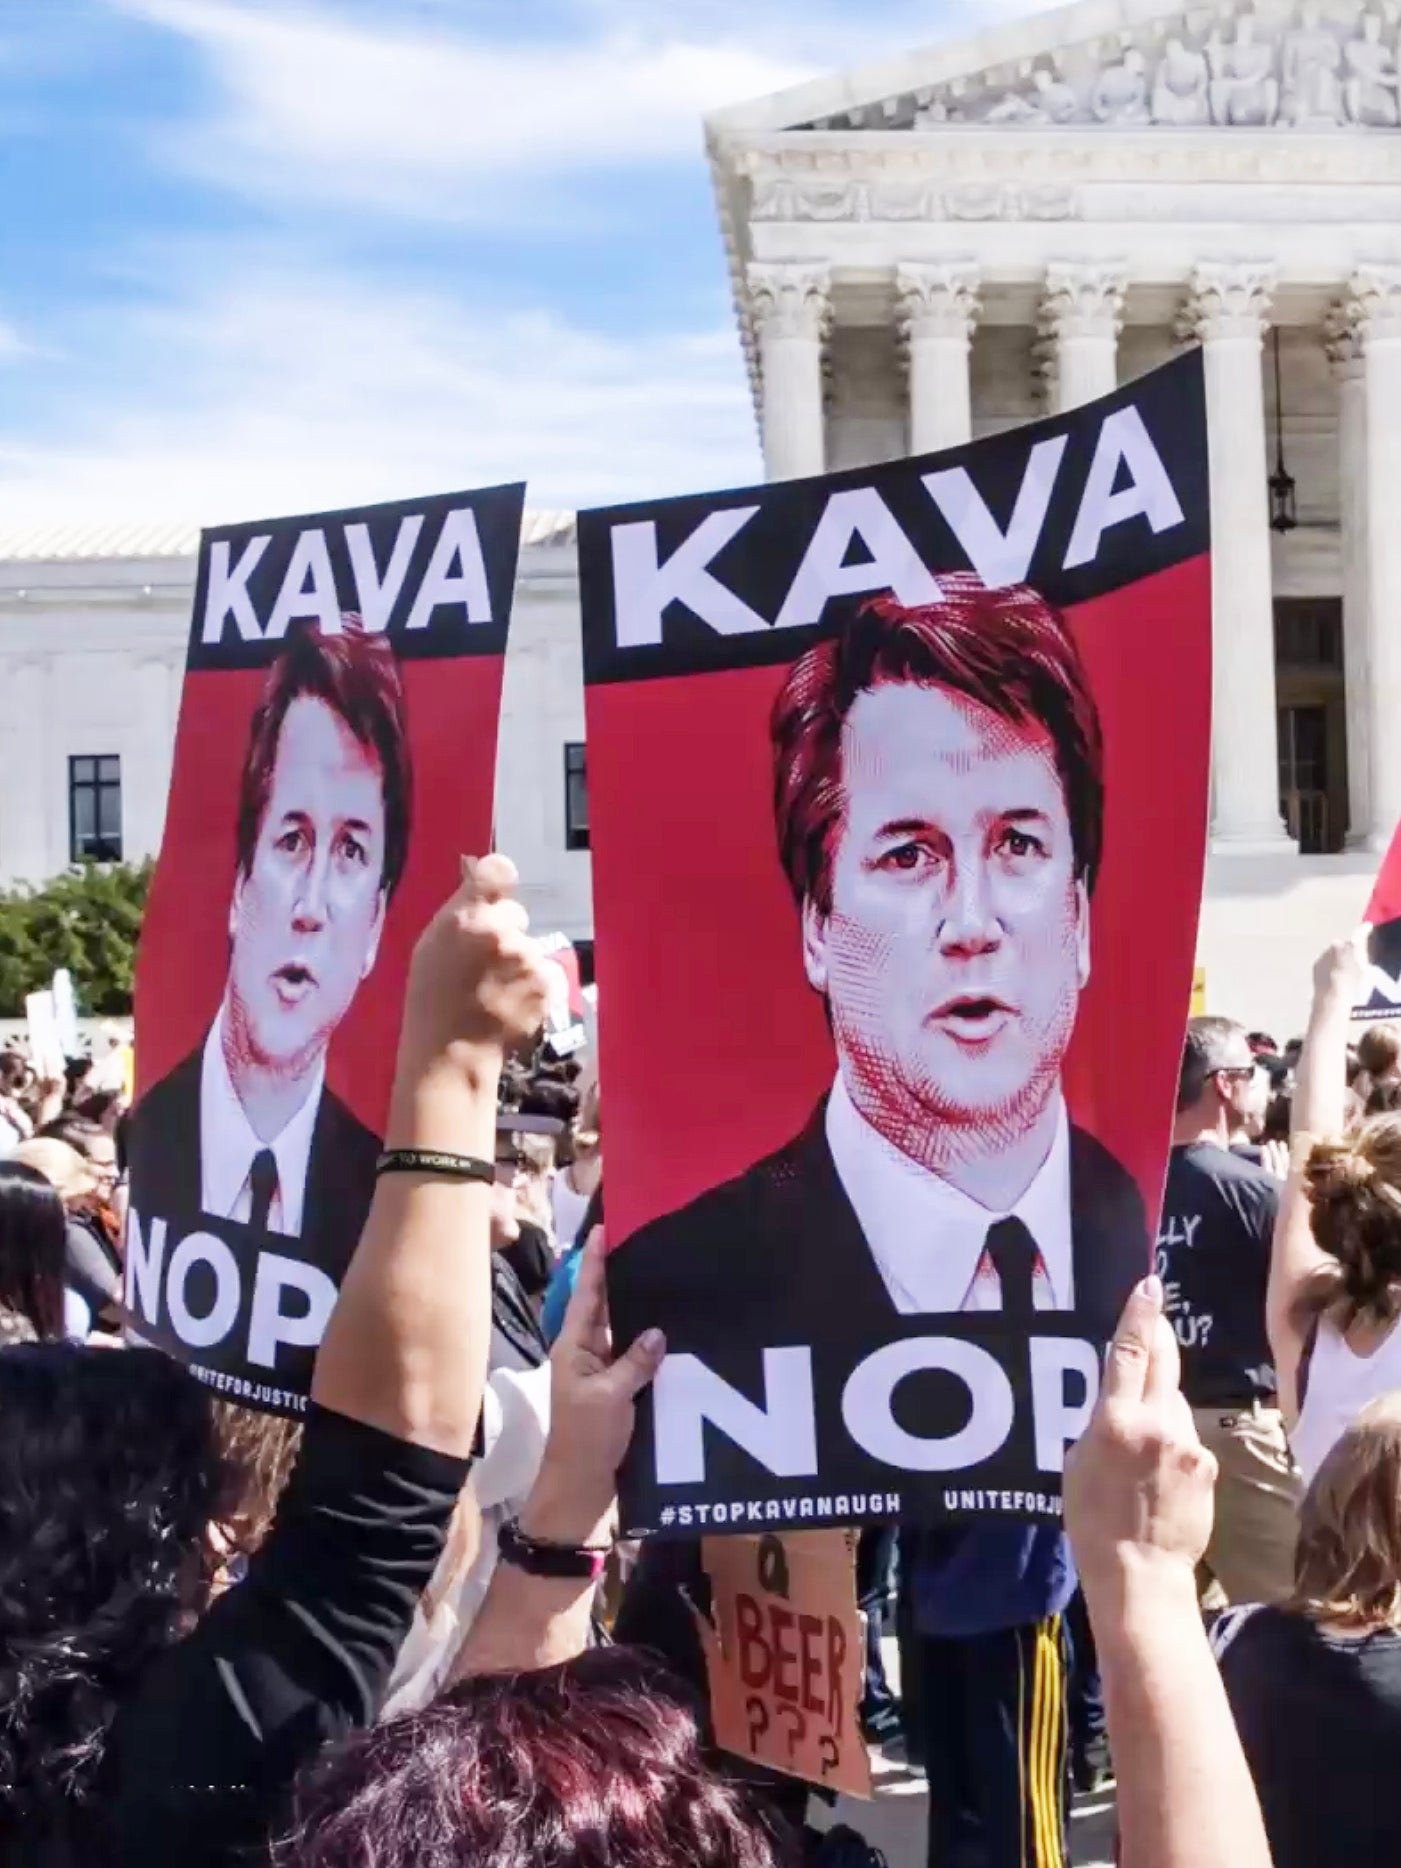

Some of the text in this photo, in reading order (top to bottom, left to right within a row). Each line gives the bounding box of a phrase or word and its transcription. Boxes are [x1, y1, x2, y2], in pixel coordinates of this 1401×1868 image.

[202, 507, 493, 644] KAVA
[610, 404, 1185, 648] KAVA
[124, 1206, 339, 1369] NOP
[653, 1335, 1113, 1485] NOP
[660, 1493, 900, 1526] #STOPKAVANAUGH
[735, 1593, 848, 1737] BEER
